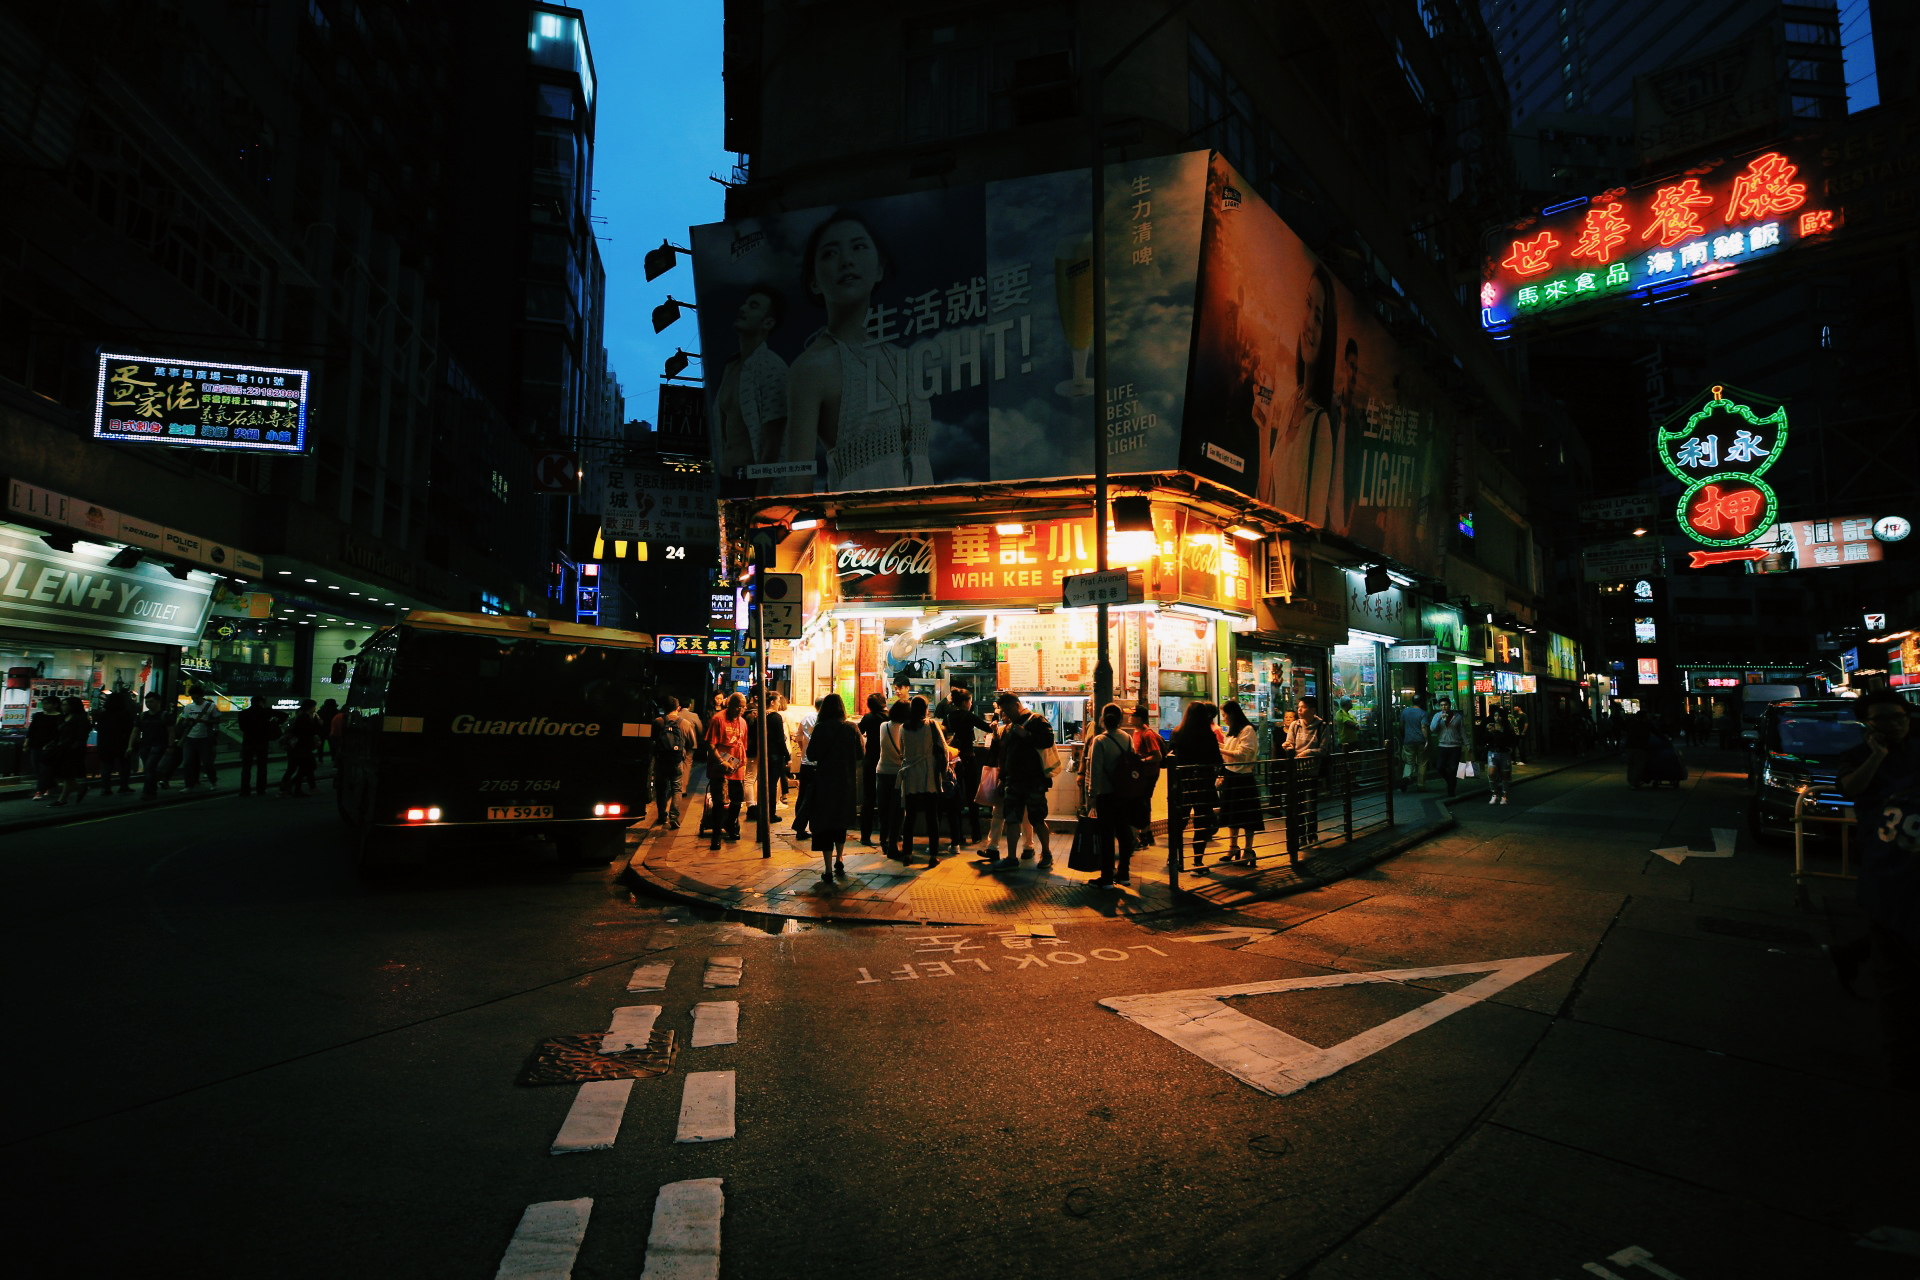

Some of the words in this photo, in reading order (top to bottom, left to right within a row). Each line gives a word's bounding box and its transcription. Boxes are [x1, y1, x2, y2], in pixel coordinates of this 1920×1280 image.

[1131, 175, 1153, 266] 生力清啤
[1502, 152, 1809, 277] 世華餐廳
[736, 241, 761, 258] LIGHT
[1647, 221, 1780, 276] 海南雞飯
[1516, 262, 1631, 309] 馬來食品
[862, 261, 1031, 348] 生活就要
[866, 314, 1032, 413] LIGHT!
[1106, 384, 1139, 403] LIFE.
[1106, 400, 1139, 421] BEST
[1107, 415, 1157, 438] SERVED
[1363, 397, 1419, 446] 生活就要
[1108, 437, 1147, 456] LIGHT.
[1359, 448, 1415, 508] LIGHT!
[12, 484, 67, 521] ELLE
[1582, 501, 1612, 512] Mobil
[1693, 485, 1761, 534] 押
[128, 527, 160, 541] DUNLOP
[166, 533, 199, 550] POLICE
[604, 529, 639, 537] Ladies
[665, 546, 686, 560] 24
[1813, 543, 1870, 564] 餐廳
[952, 572, 994, 589] WAH
[1003, 570, 1043, 588] KEE
[1080, 576, 1095, 587] Prat
[1097, 573, 1126, 585] Avenue
[133, 599, 181, 621] OUTLET
[784, 606, 792, 617] 7
[783, 624, 792, 635] 7
[451, 714, 601, 737] Guardforce
[478, 779, 519, 792] 2765
[523, 779, 561, 791] 7654
[490, 808, 510, 819] TY
[513, 806, 551, 818] 5949
[1004, 944, 1169, 971] LOOK
[855, 957, 993, 985] LEFT
